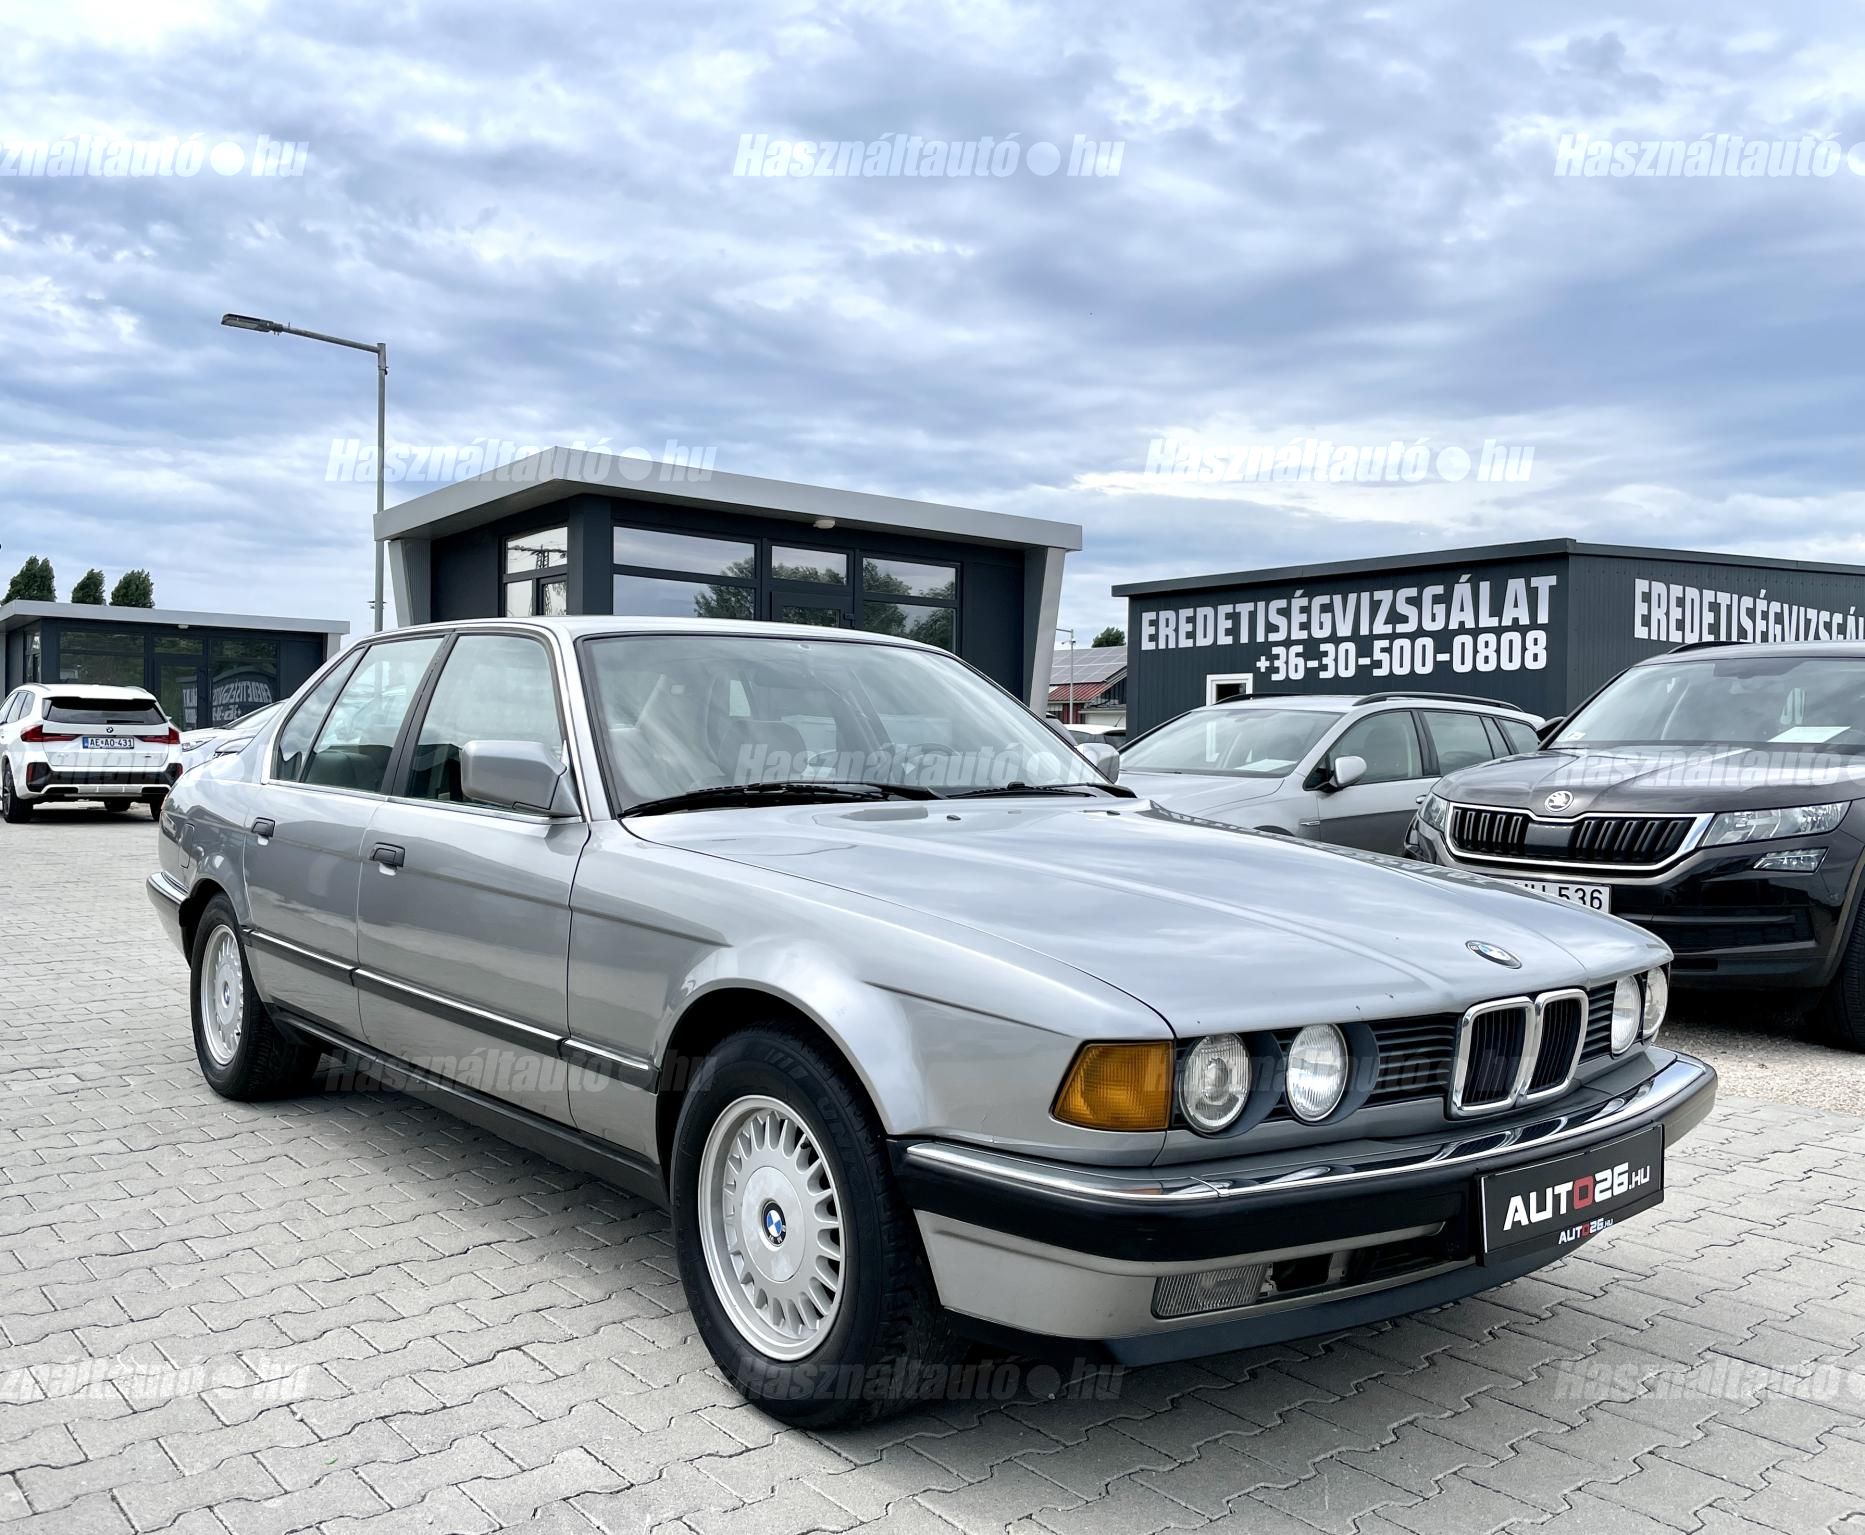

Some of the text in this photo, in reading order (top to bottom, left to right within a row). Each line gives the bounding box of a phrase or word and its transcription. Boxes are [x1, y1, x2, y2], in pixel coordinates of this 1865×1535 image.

[1141, 574, 1557, 651] EREDETISÉGVIZSGÁLAT
[1255, 629, 1547, 681] +36-30-500-0808
[1503, 1162, 1650, 1230] AUTO26.HU
[1558, 1217, 1614, 1245] AUTO26.HU
